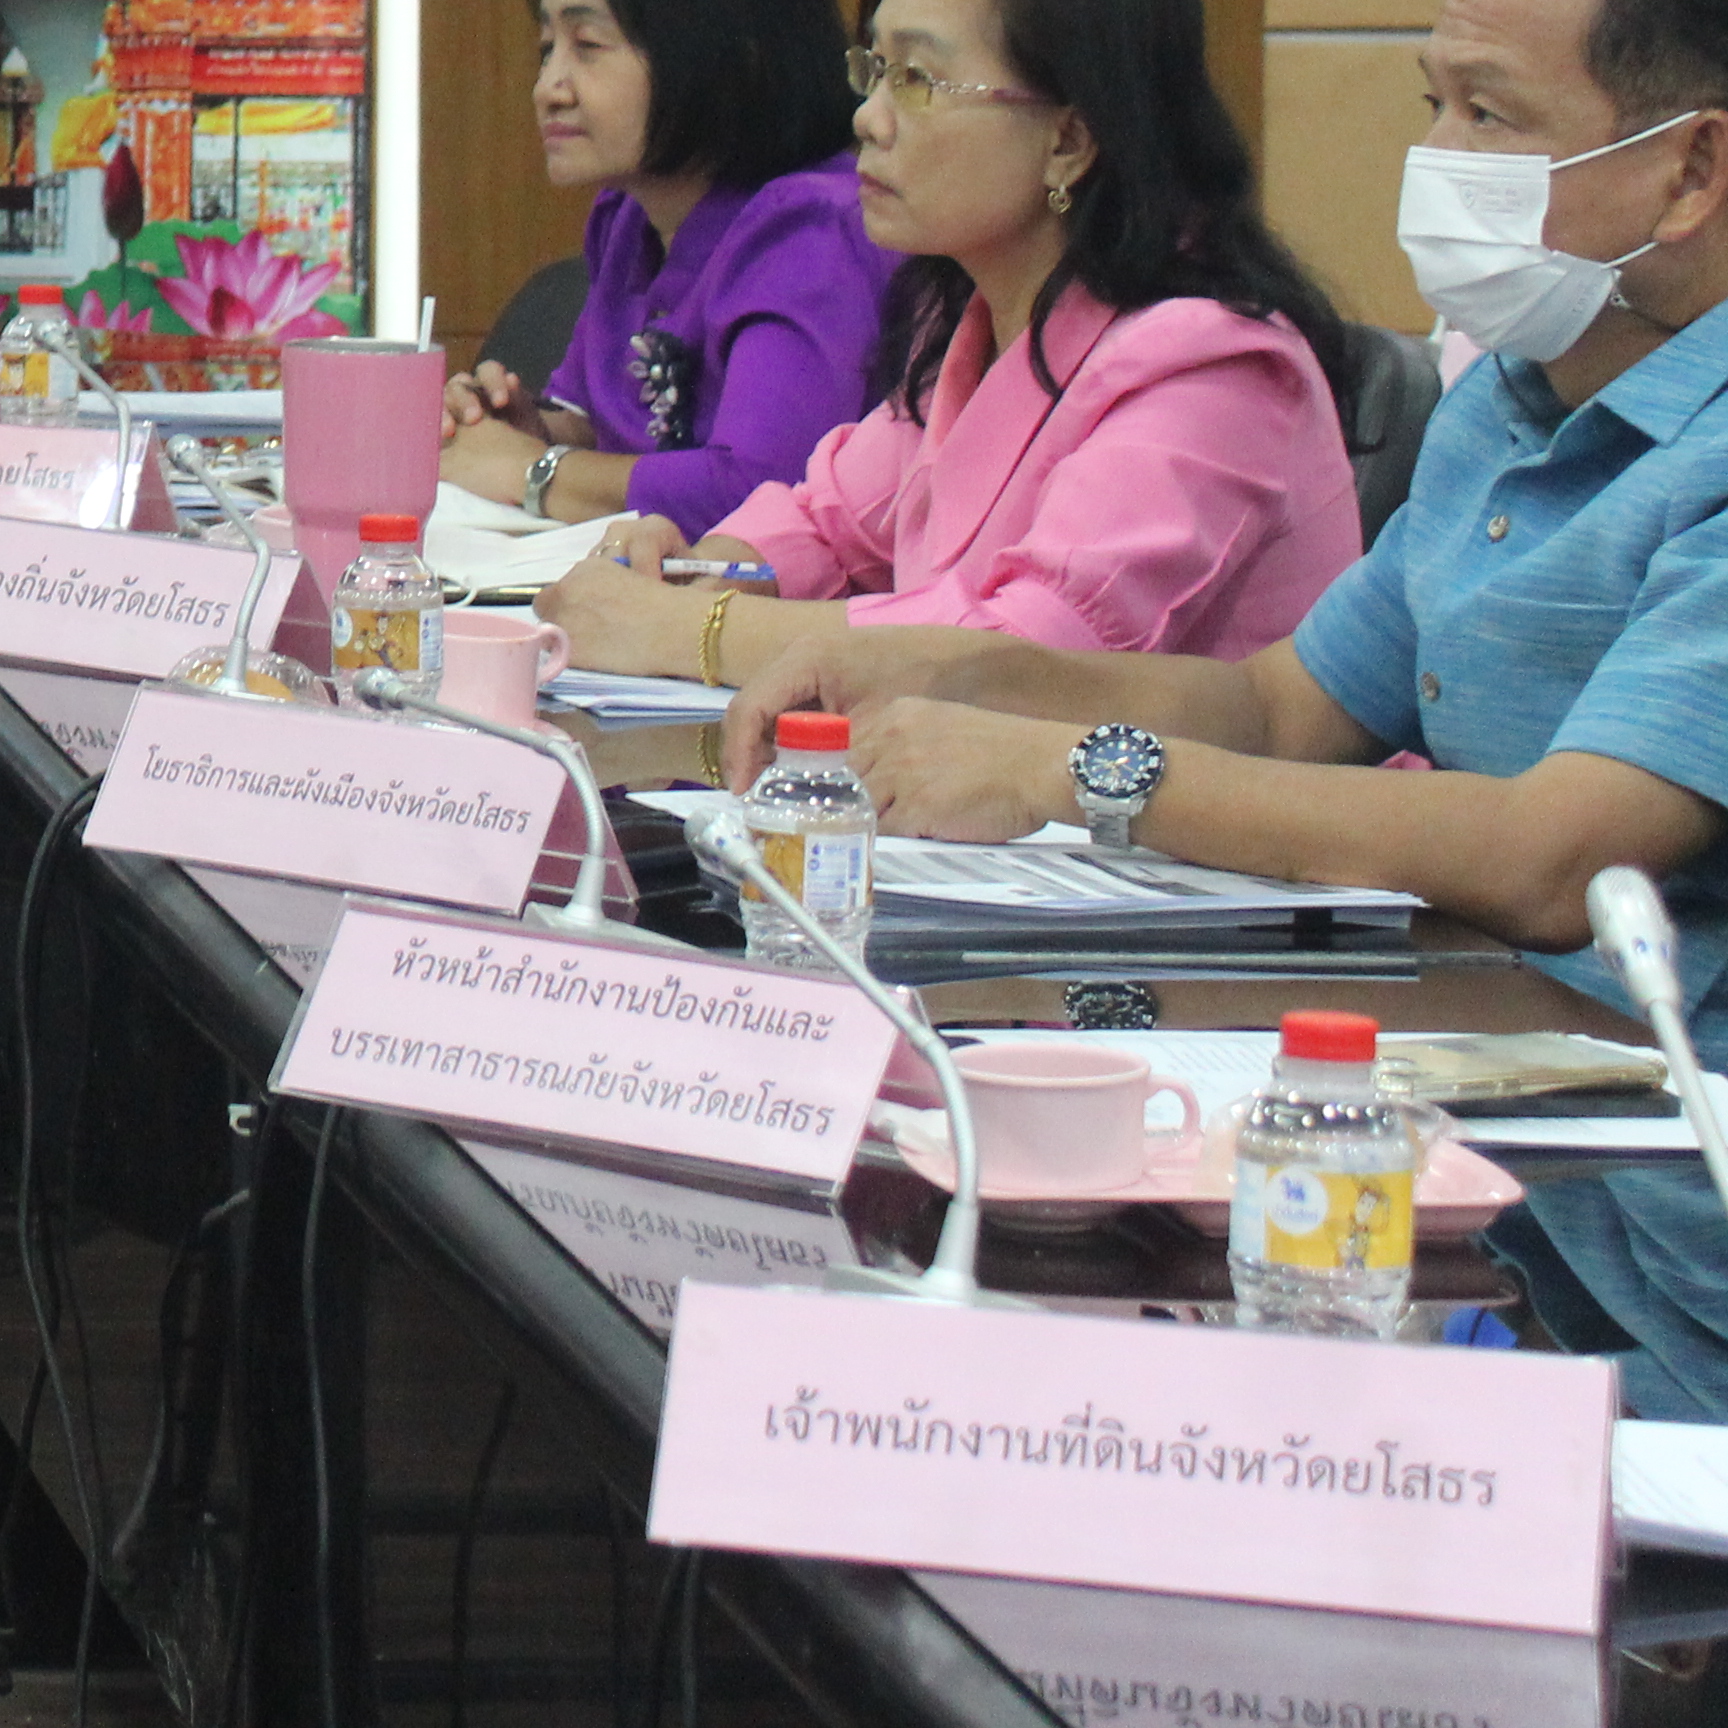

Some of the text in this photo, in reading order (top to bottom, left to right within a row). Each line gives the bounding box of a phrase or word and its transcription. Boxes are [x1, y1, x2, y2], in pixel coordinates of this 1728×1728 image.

[141, 744, 532, 836] โยธาธิการและผังเมืองจังหวัดยโสธร
[392, 935, 835, 1043] หัวหน้าสำนักงานป้องกันและ
[329, 1023, 835, 1138] บรรเทาสาธารณภัยจังหวัดยโสธร
[763, 1386, 1499, 1510] เจ้าพนักงานที่ดินจังหวัดยโสธร
